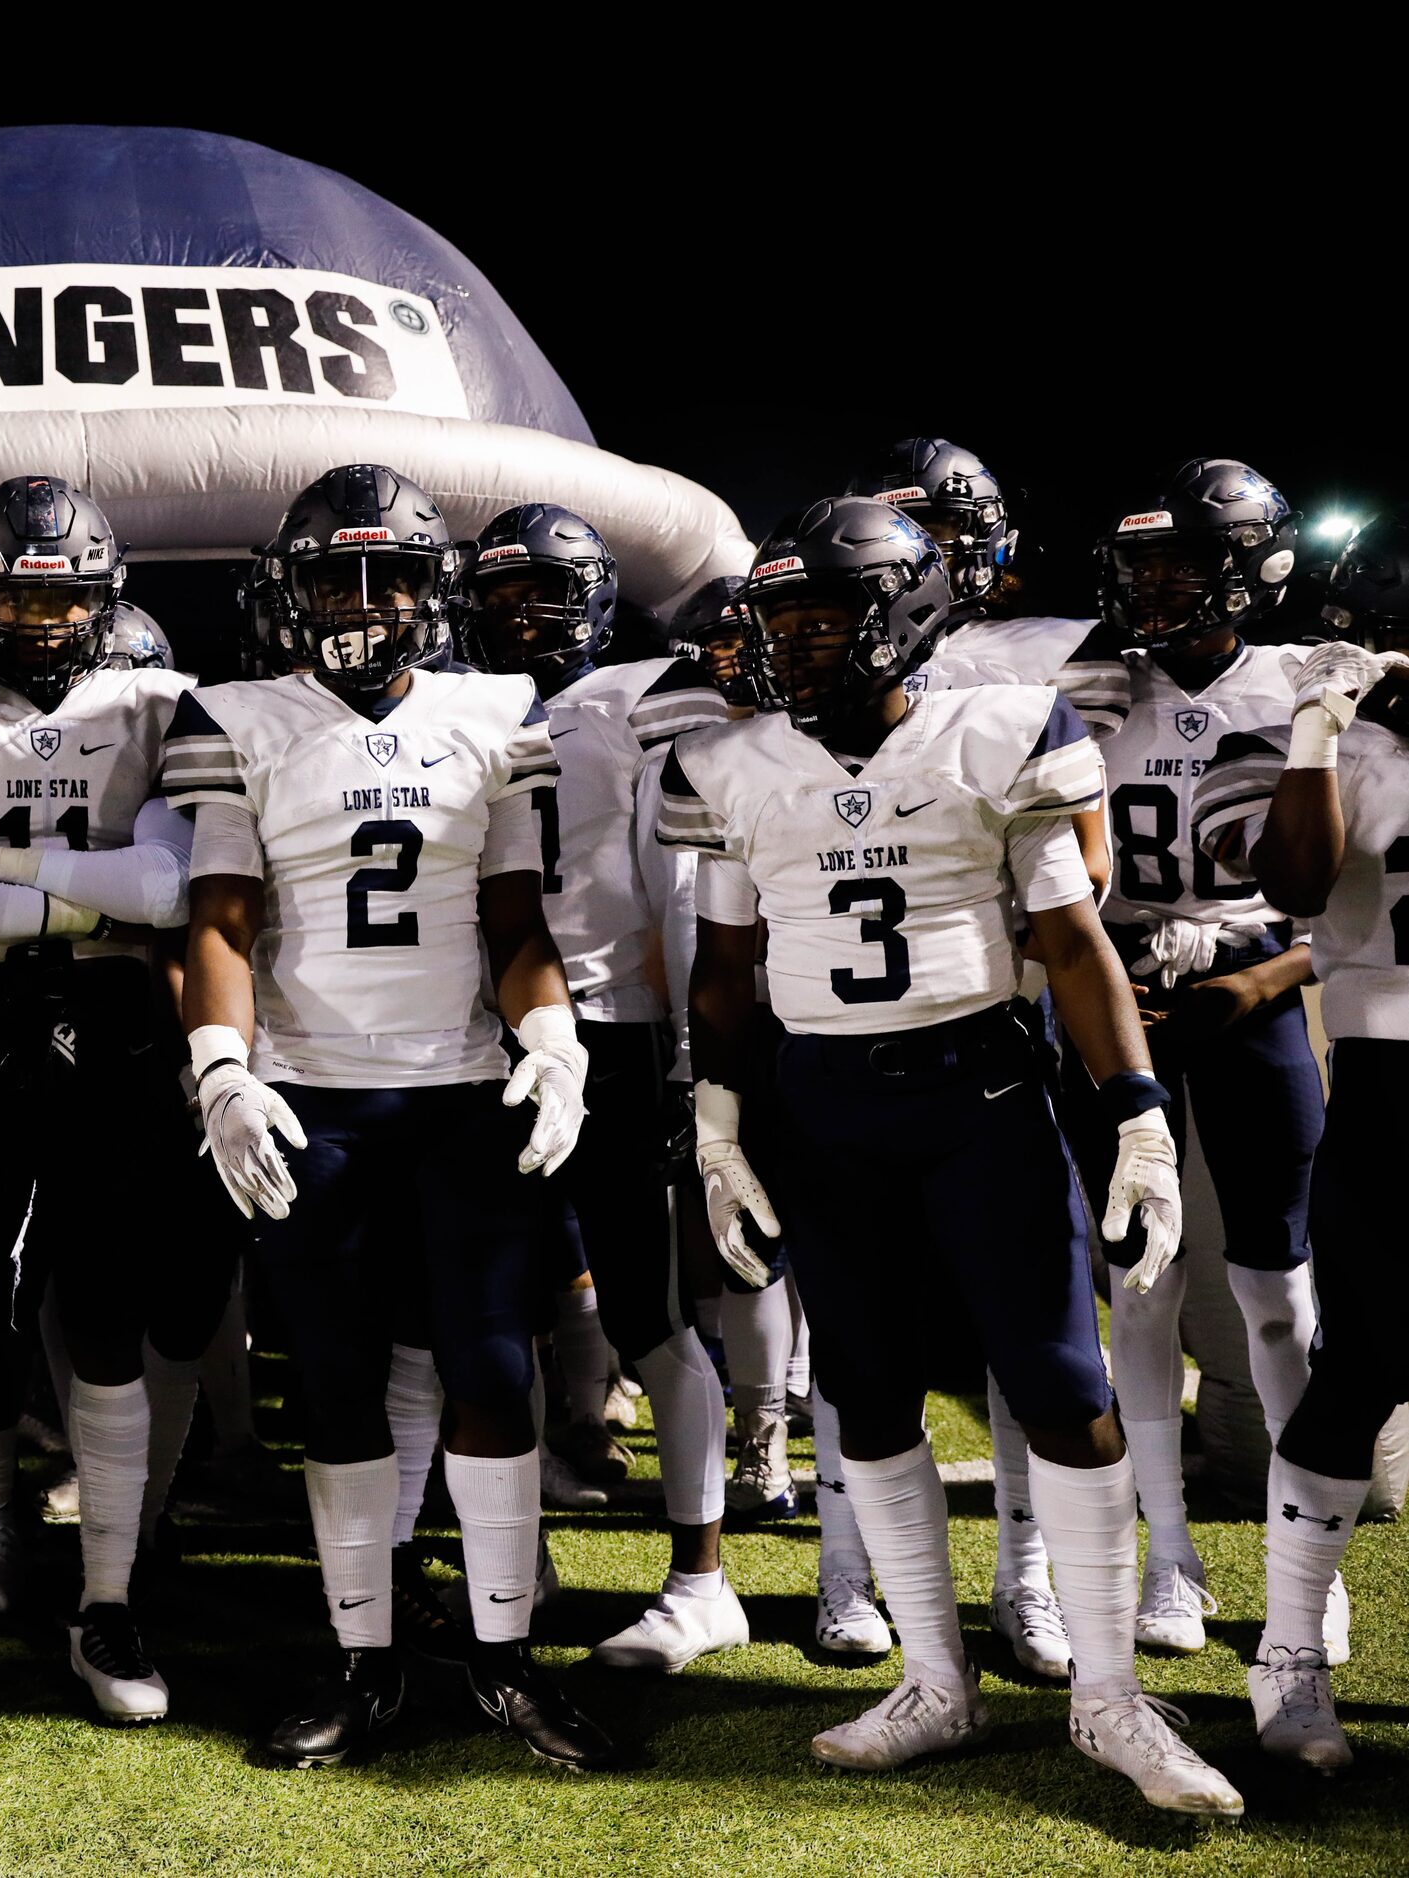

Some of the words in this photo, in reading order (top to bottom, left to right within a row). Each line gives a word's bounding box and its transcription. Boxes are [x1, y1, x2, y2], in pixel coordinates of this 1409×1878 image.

[338, 529, 389, 542] Riddell
[86, 546, 105, 561] NIKE
[19, 558, 66, 570] Riddell
[754, 558, 796, 578] Riddell
[1144, 758, 1183, 776] LONE
[6, 779, 42, 799] LONE
[49, 778, 89, 799] STAR
[343, 788, 382, 811] LONE
[391, 787, 431, 807] STAR
[816, 849, 856, 871] LONE
[863, 845, 909, 868] STAR
[346, 819, 424, 949] 2
[827, 876, 912, 1005] 3
[272, 1061, 289, 1071] NIKE
[288, 1065, 305, 1075] PRO
